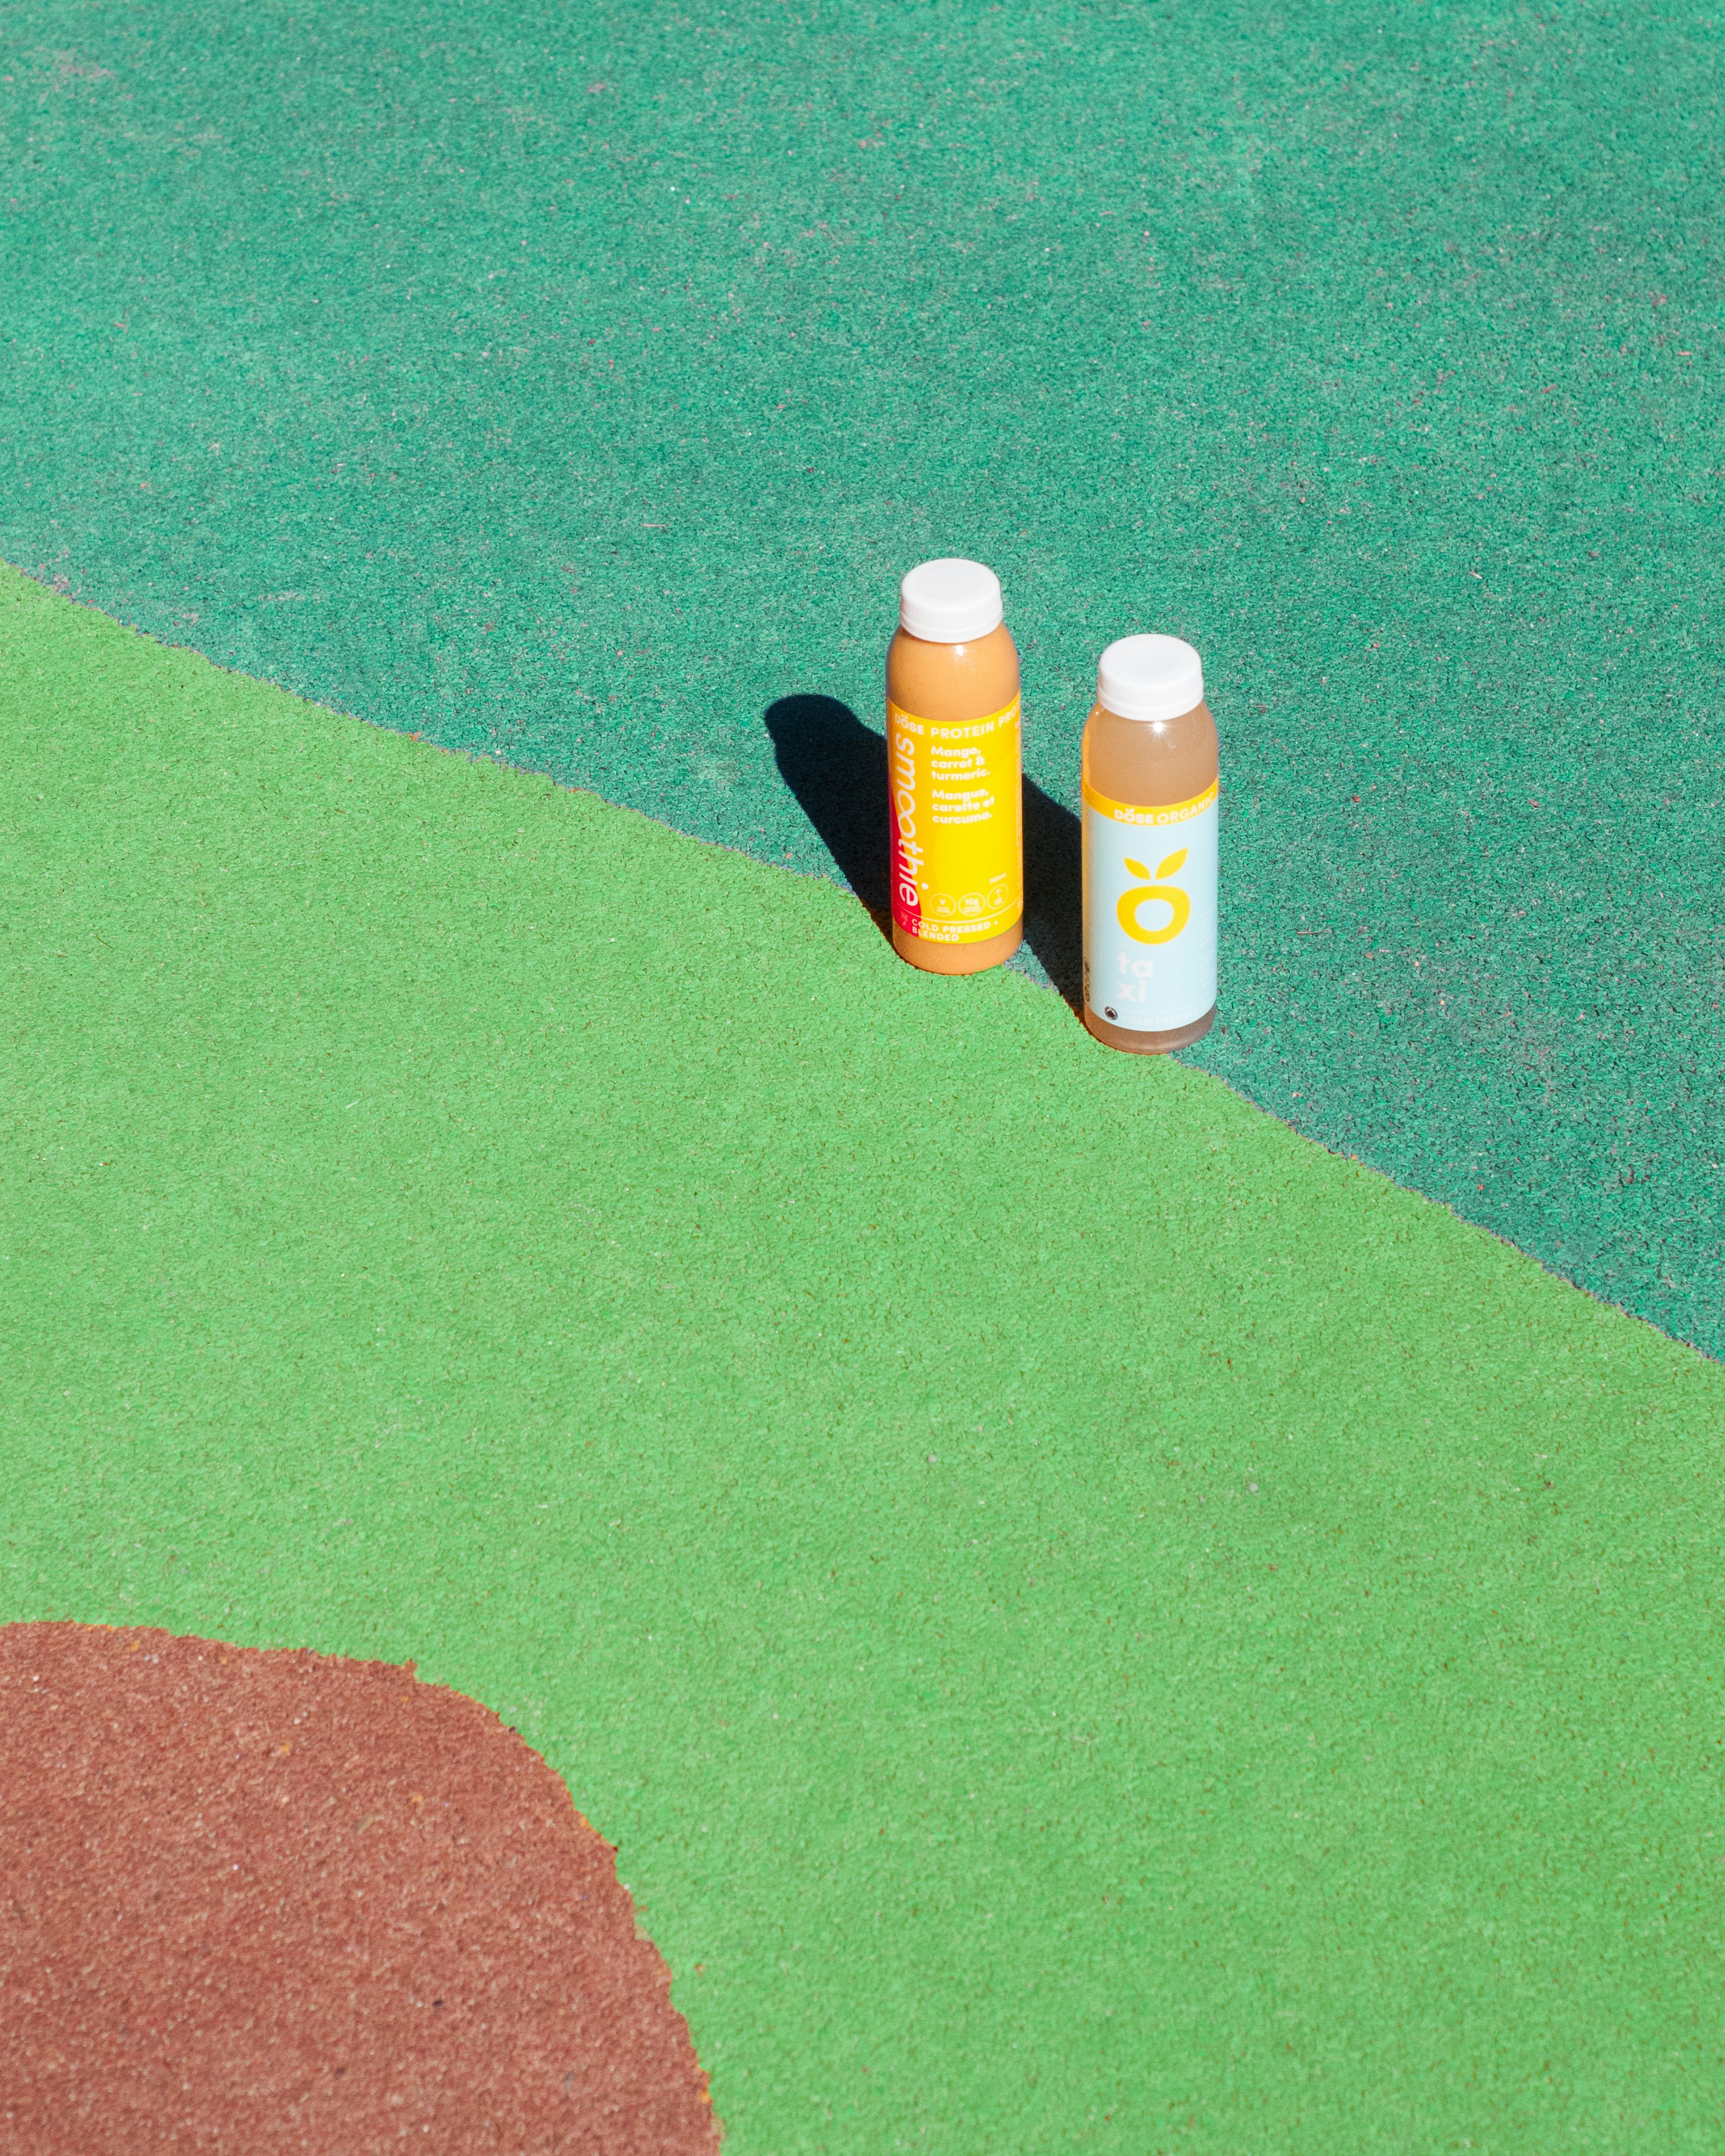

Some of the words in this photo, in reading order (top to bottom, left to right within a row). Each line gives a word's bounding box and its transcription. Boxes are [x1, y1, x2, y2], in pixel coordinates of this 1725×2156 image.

[931, 722, 994, 739] PROTEIN
[931, 746, 981, 758] Mango,
[931, 758, 973, 769] carrot
[975, 756, 985, 765] &
[931, 768, 990, 781] turmeric.
[932, 788, 989, 802] Mangue,
[932, 801, 981, 812] carotte
[983, 796, 995, 808] et
[1157, 791, 1214, 823] ORGANIC
[895, 733, 929, 907] smoothie
[932, 811, 992, 825] curcuma.
[912, 918, 939, 932] COLD
[943, 921, 991, 934] PRESSED
[912, 927, 960, 941] BLENDED
[1117, 951, 1155, 978] ta
[1117, 979, 1147, 1004] xi
